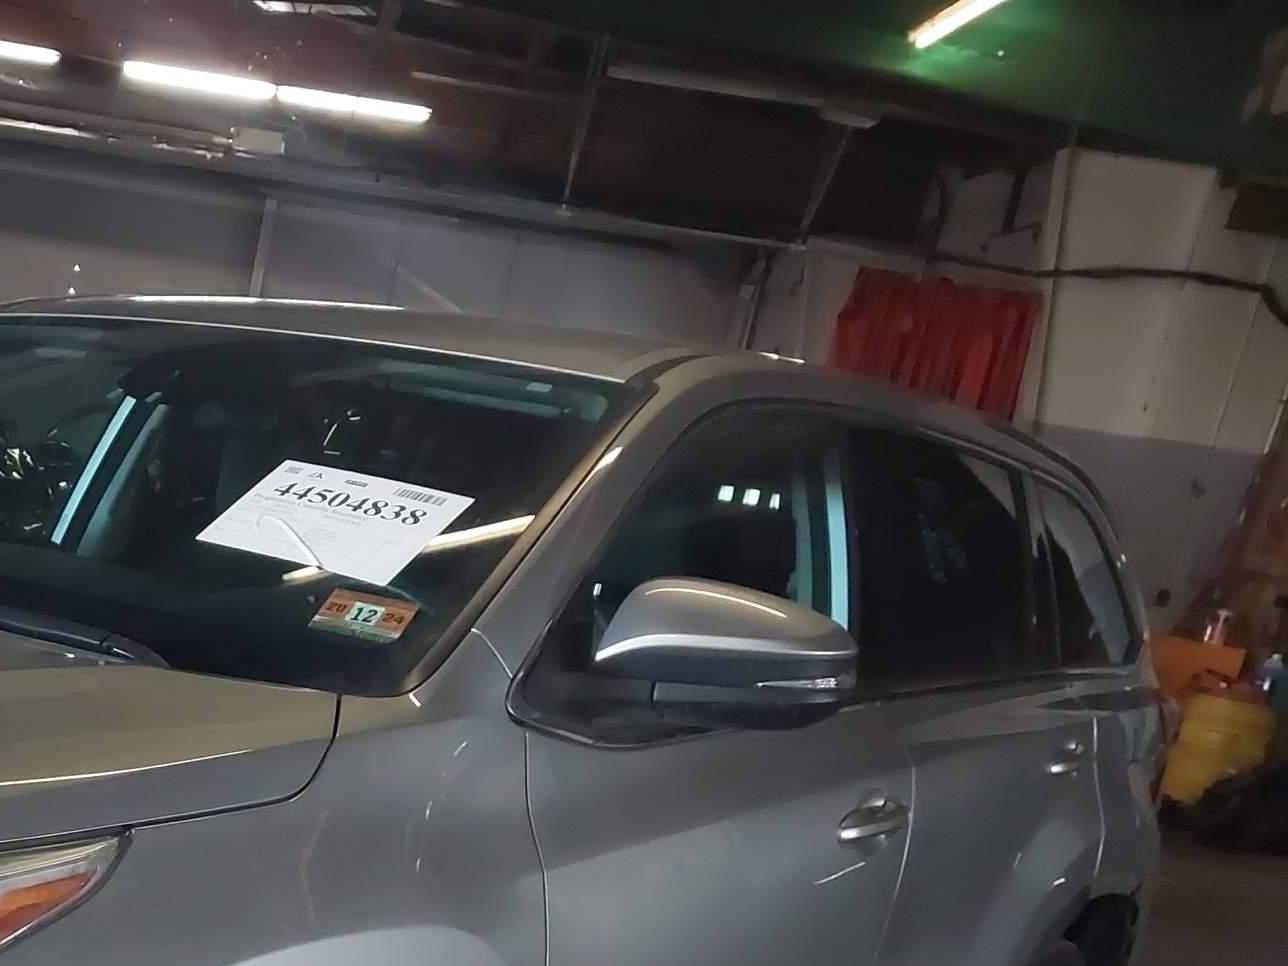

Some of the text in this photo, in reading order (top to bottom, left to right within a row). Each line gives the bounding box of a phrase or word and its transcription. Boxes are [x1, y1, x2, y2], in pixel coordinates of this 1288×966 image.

[273, 481, 428, 526] 44504838
[326, 601, 405, 625] 20 12 24
